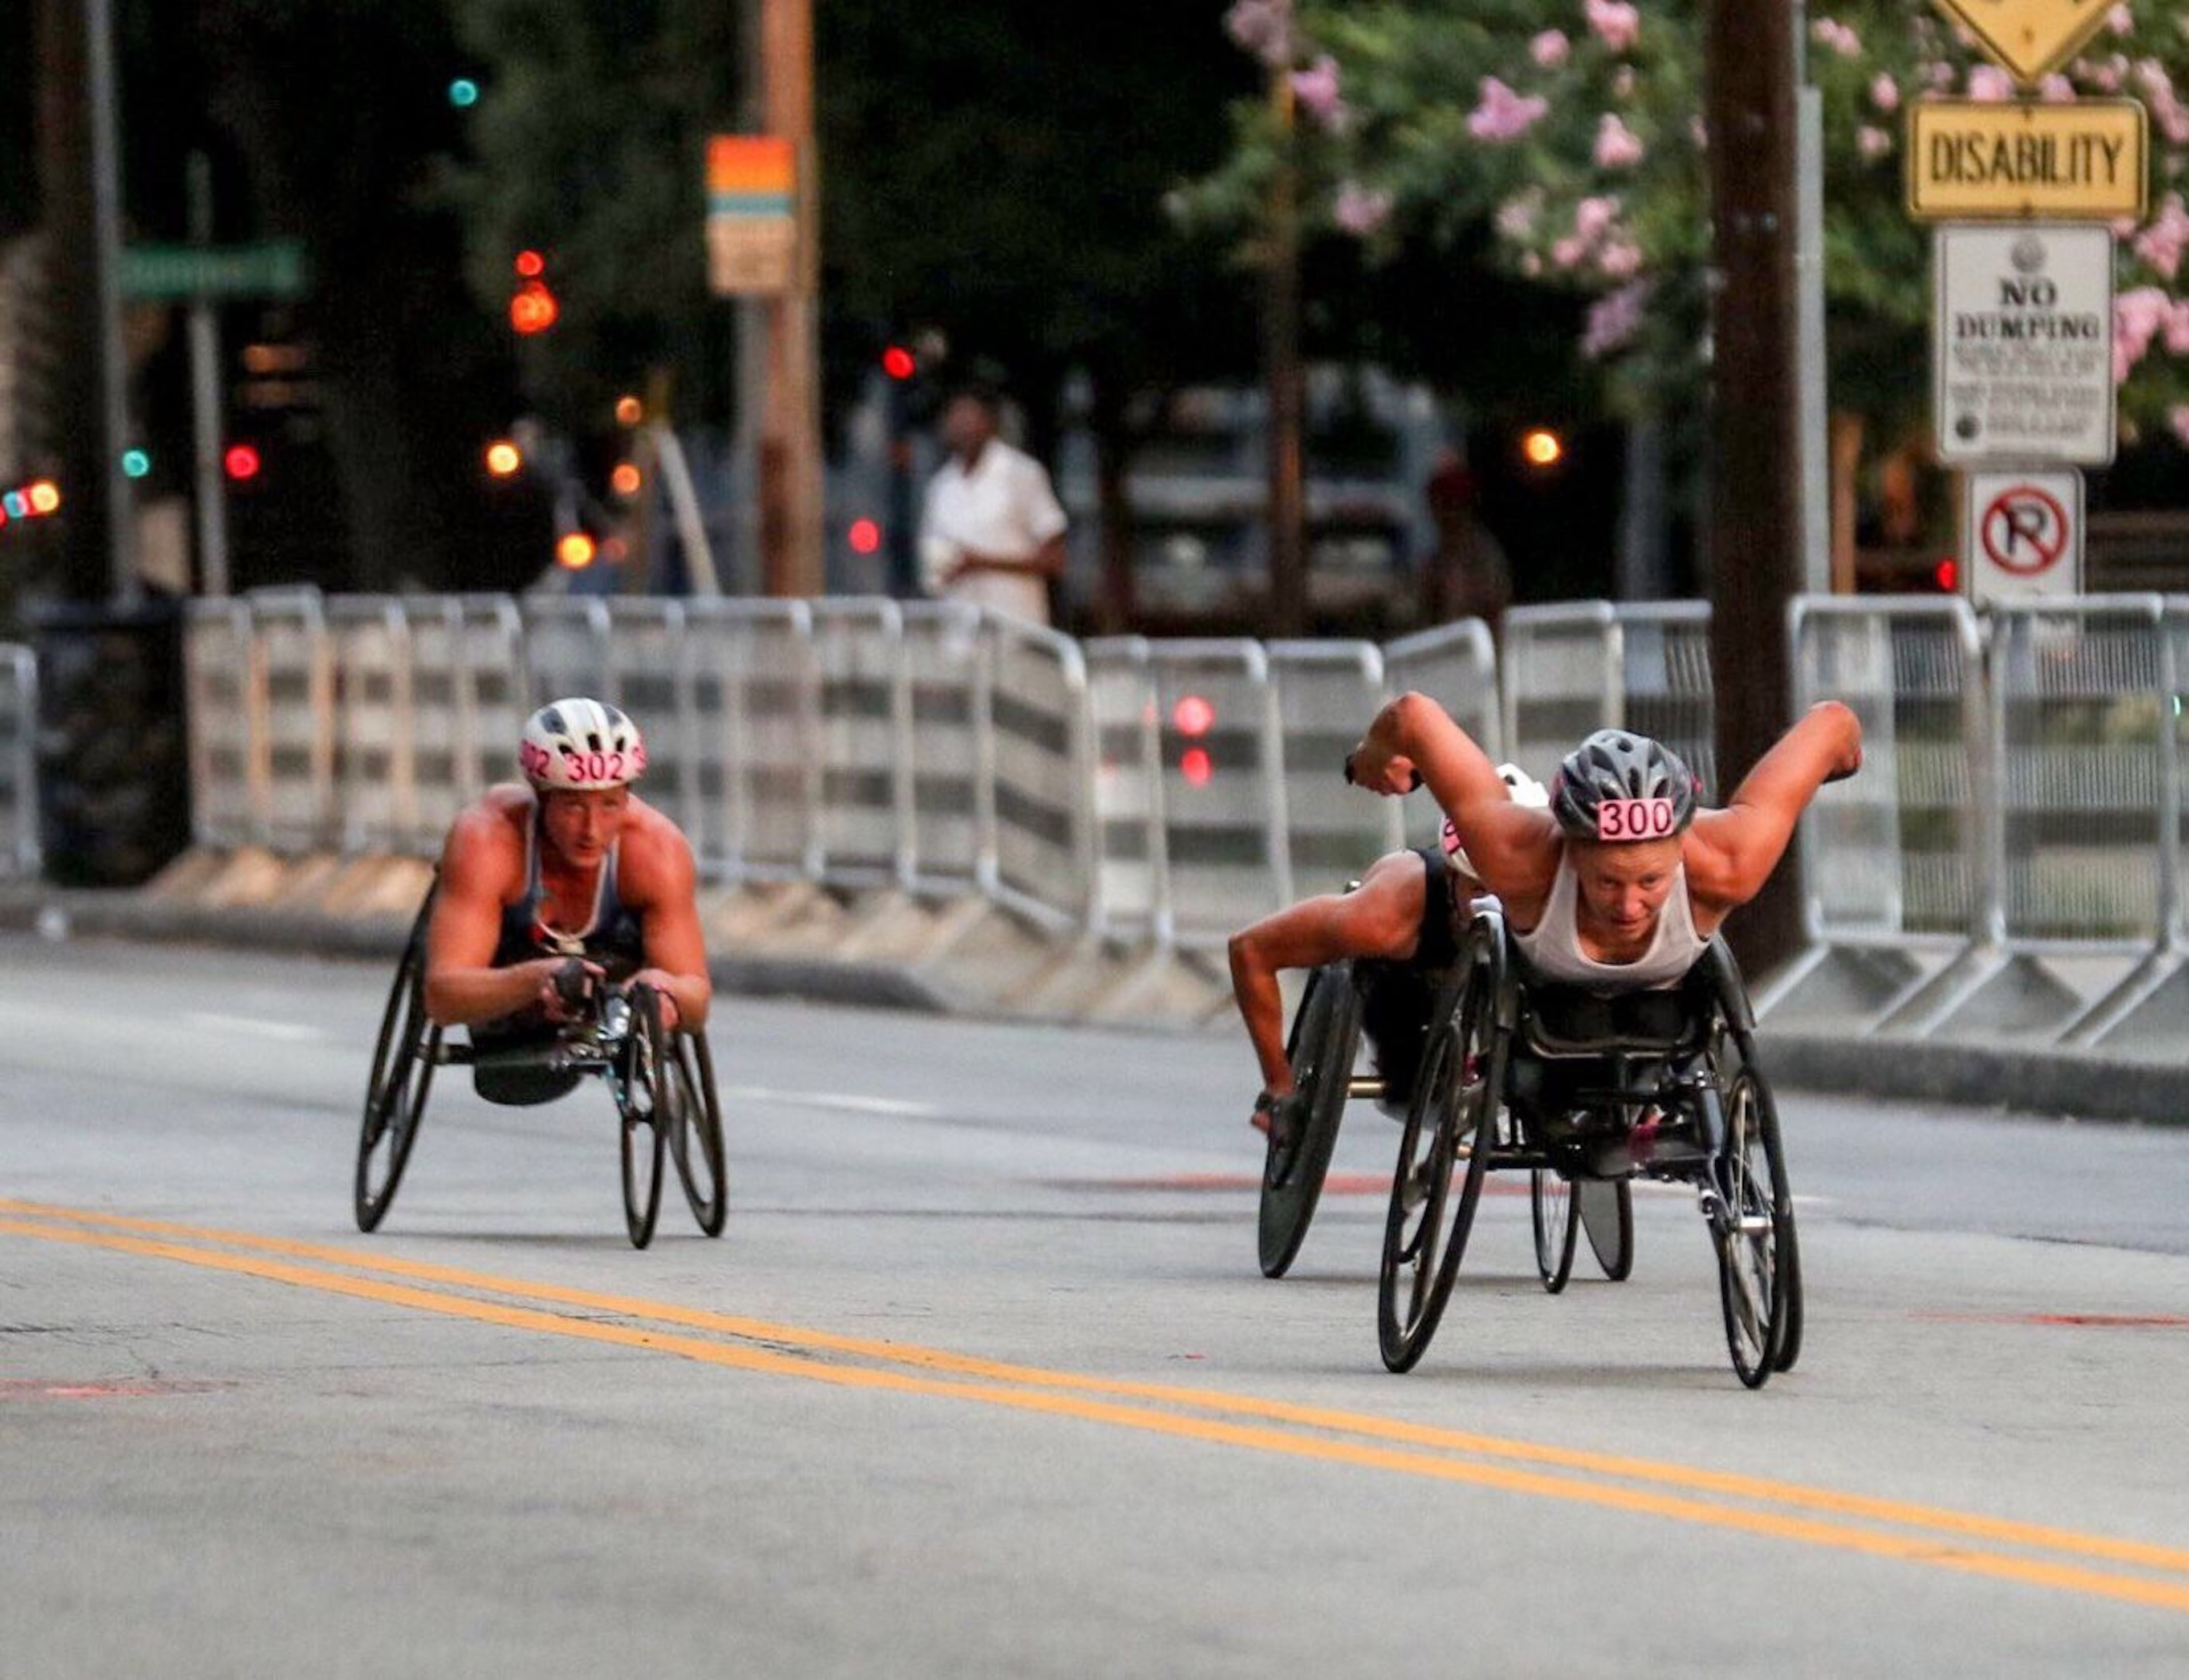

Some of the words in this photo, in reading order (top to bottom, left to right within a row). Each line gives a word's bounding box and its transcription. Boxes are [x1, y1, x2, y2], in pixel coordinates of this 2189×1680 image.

[1930, 131, 2122, 185] DISABILITY
[2000, 277, 2057, 306] NO
[1956, 312, 2100, 339] DUMPING
[568, 752, 623, 782] 302
[1602, 802, 1671, 835] 300
